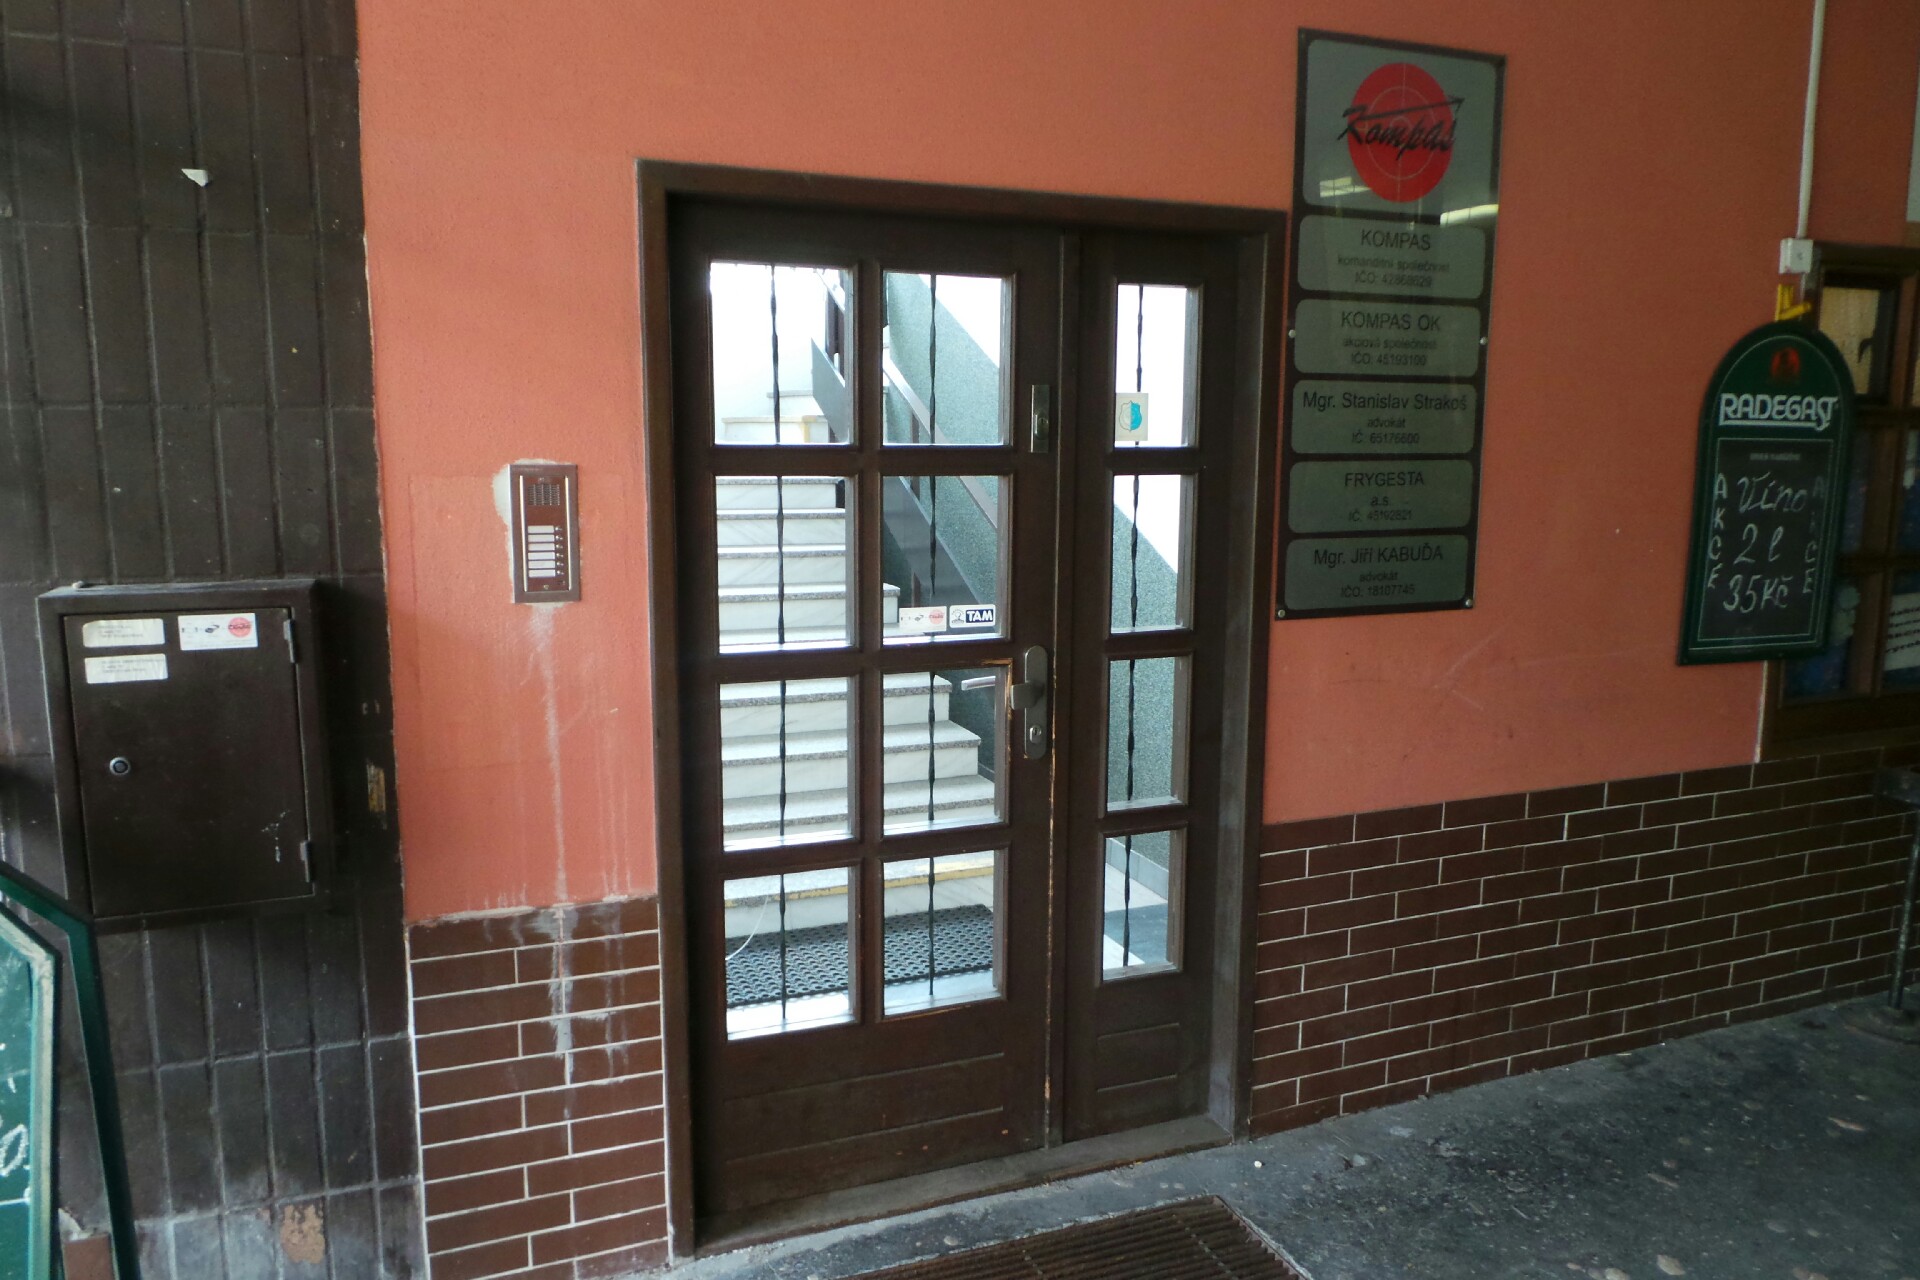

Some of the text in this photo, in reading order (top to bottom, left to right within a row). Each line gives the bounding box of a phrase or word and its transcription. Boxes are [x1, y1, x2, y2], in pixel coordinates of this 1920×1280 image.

[1360, 229, 1431, 251] KOMPAS
[1341, 310, 1441, 331] KOMPAS OK
[1303, 391, 1467, 412] Mgr. Stanislav Strakoš
[1719, 393, 1839, 431] RADEGAST
[1345, 471, 1424, 487] FRYGESTA
[1733, 523, 1758, 564] 2
[1314, 542, 1444, 568] Mgr. Jiří KABUĎA
[966, 609, 994, 622] TAM
